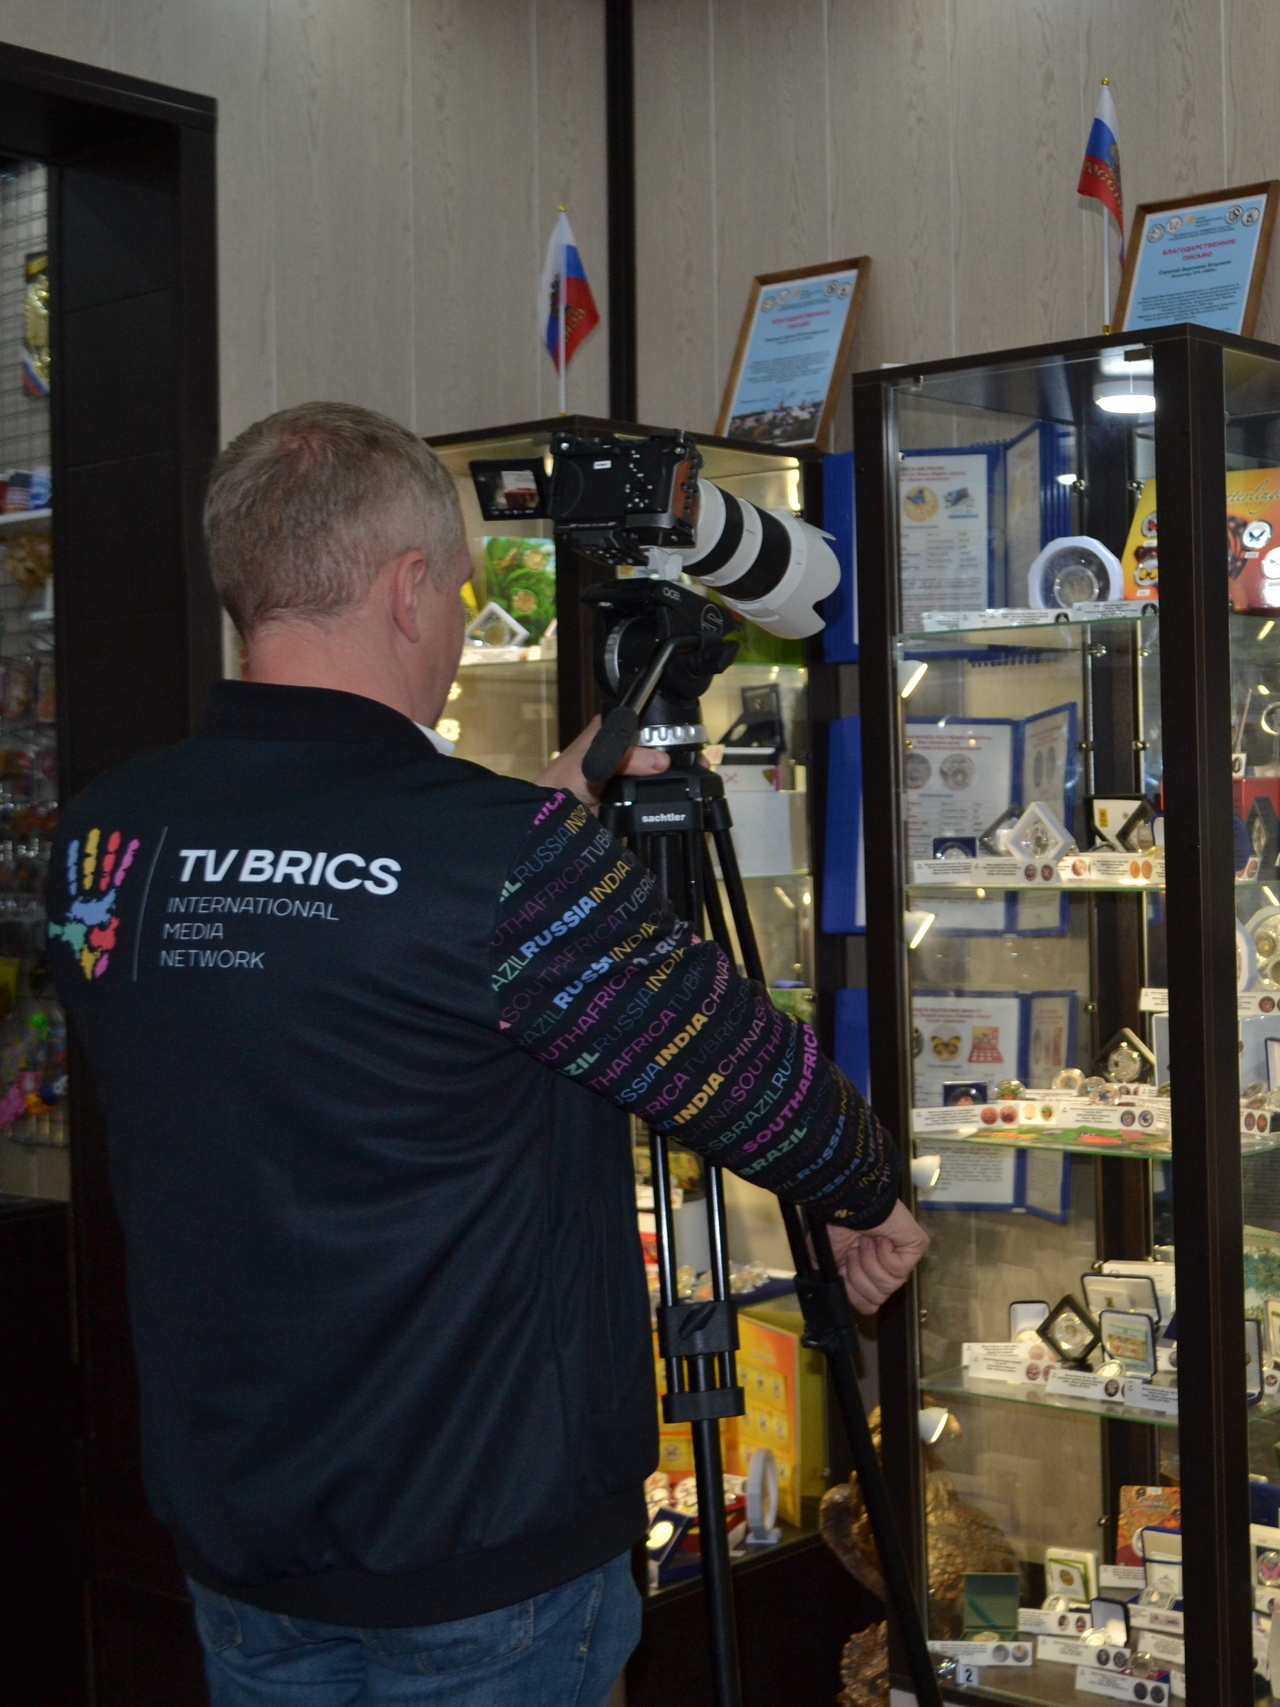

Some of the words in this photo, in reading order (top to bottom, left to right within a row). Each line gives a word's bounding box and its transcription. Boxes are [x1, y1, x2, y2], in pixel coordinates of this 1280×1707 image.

[642, 813, 686, 823] sachtler
[179, 849, 239, 882] TV
[239, 849, 402, 895] BRICS
[167, 897, 340, 921] INTERNATIONAL
[163, 923, 224, 940] MEDIA
[160, 949, 266, 969] NETWORK
[654, 1012, 709, 1067] INDIA
[673, 1072, 725, 1124] INDIA
[965, 1668, 973, 1682] 2
